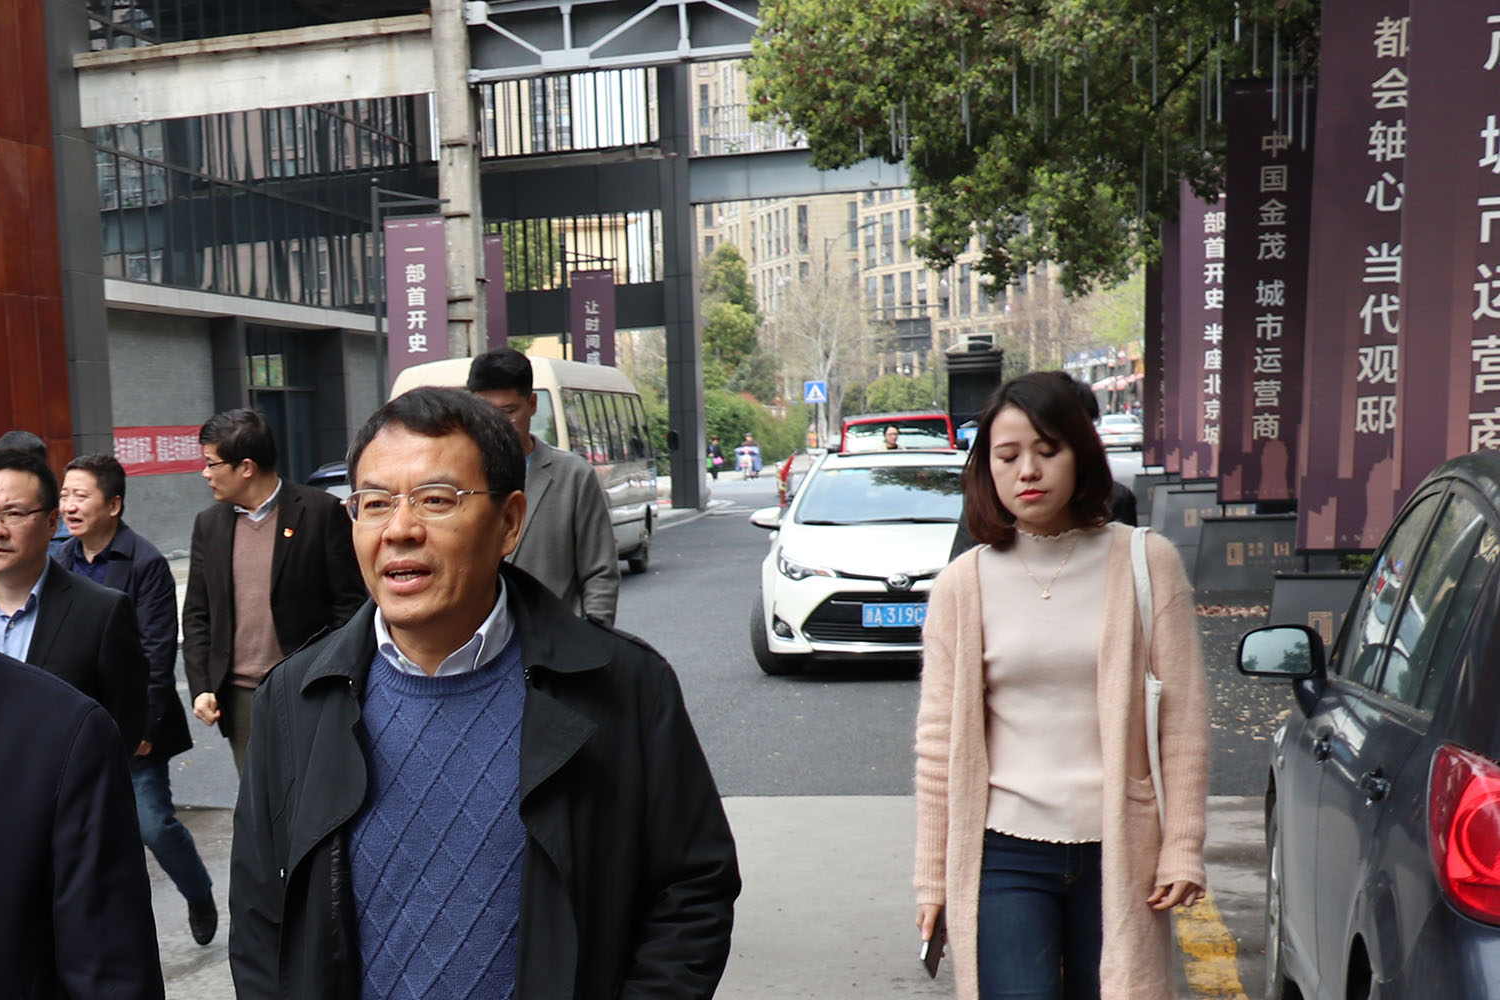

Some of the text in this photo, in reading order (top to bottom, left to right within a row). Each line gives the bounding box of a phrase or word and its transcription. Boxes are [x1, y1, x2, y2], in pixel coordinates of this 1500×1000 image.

[404, 246, 428, 353] 一部首开史
[1203, 192, 1227, 310] 部首开史
[1252, 130, 1288, 441] 中国金茂 城市运营商
[1355, 15, 1411, 434] 都会轴心 当代观邸
